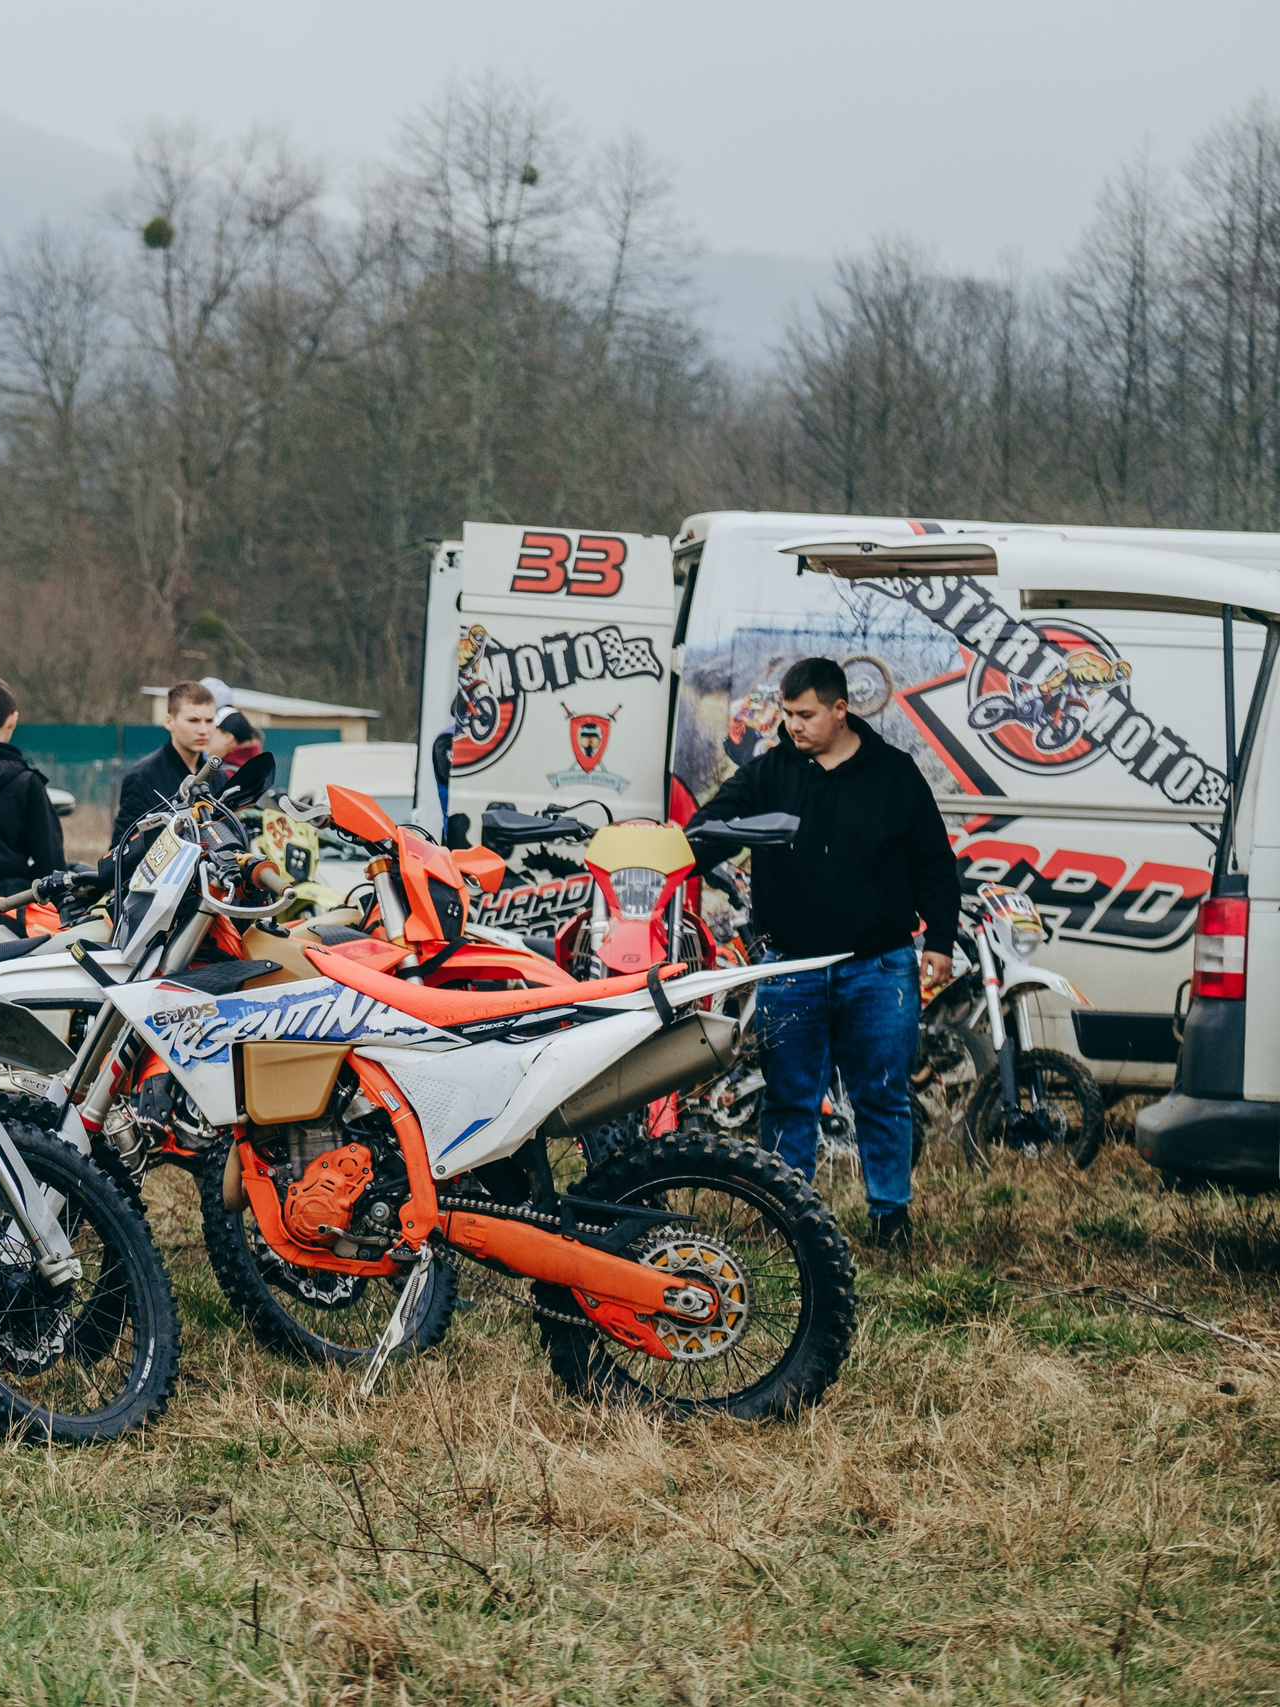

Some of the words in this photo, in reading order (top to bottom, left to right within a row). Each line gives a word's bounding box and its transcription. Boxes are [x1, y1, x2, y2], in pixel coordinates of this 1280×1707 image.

[510, 531, 628, 598] 33
[475, 634, 606, 698] MOTO
[1080, 681, 1205, 802] MOTO
[266, 816, 293, 850] 33
[475, 872, 594, 928] HARD
[948, 836, 1213, 942] ARD
